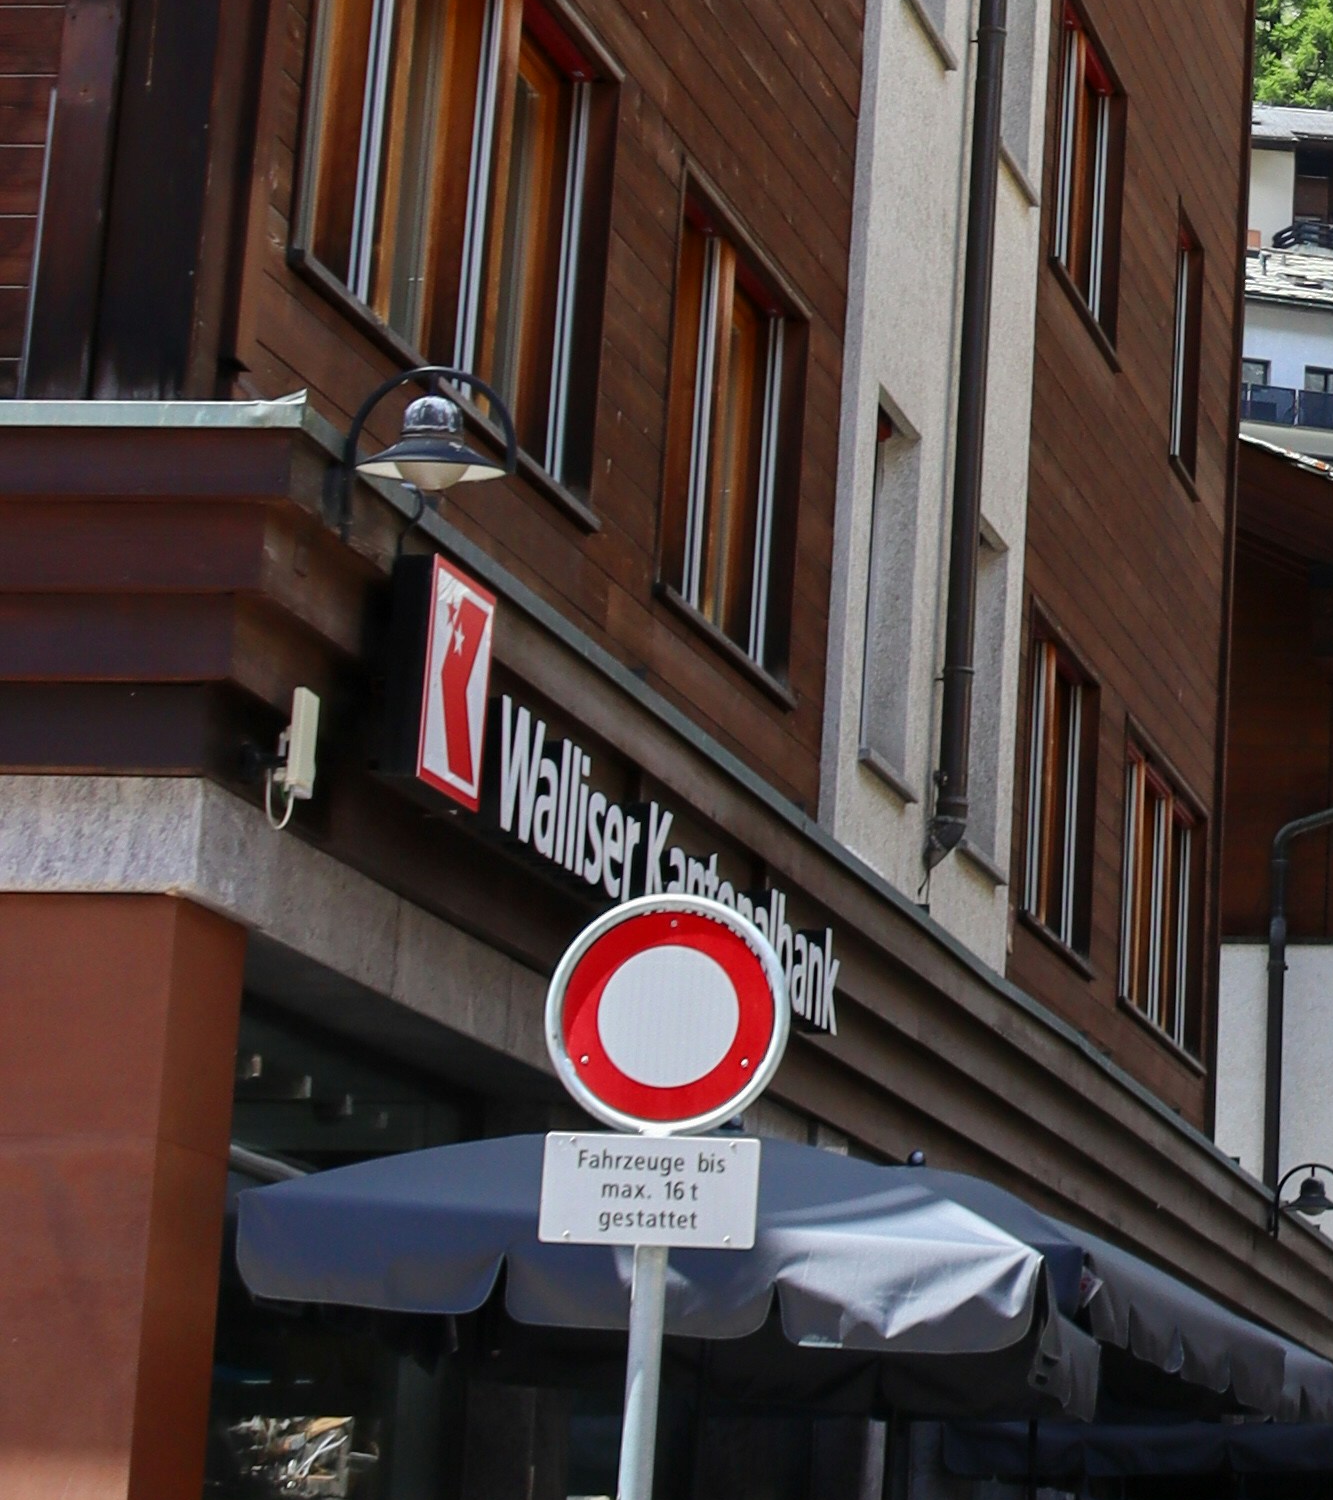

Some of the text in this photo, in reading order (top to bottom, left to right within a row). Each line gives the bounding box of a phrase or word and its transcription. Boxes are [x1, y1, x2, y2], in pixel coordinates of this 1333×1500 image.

[500, 695, 641, 903] Walliser
[577, 1149, 726, 1176] Fahrzeuge bis
[600, 1181, 699, 1201] max. 16 t
[598, 1210, 698, 1232] gestattet
